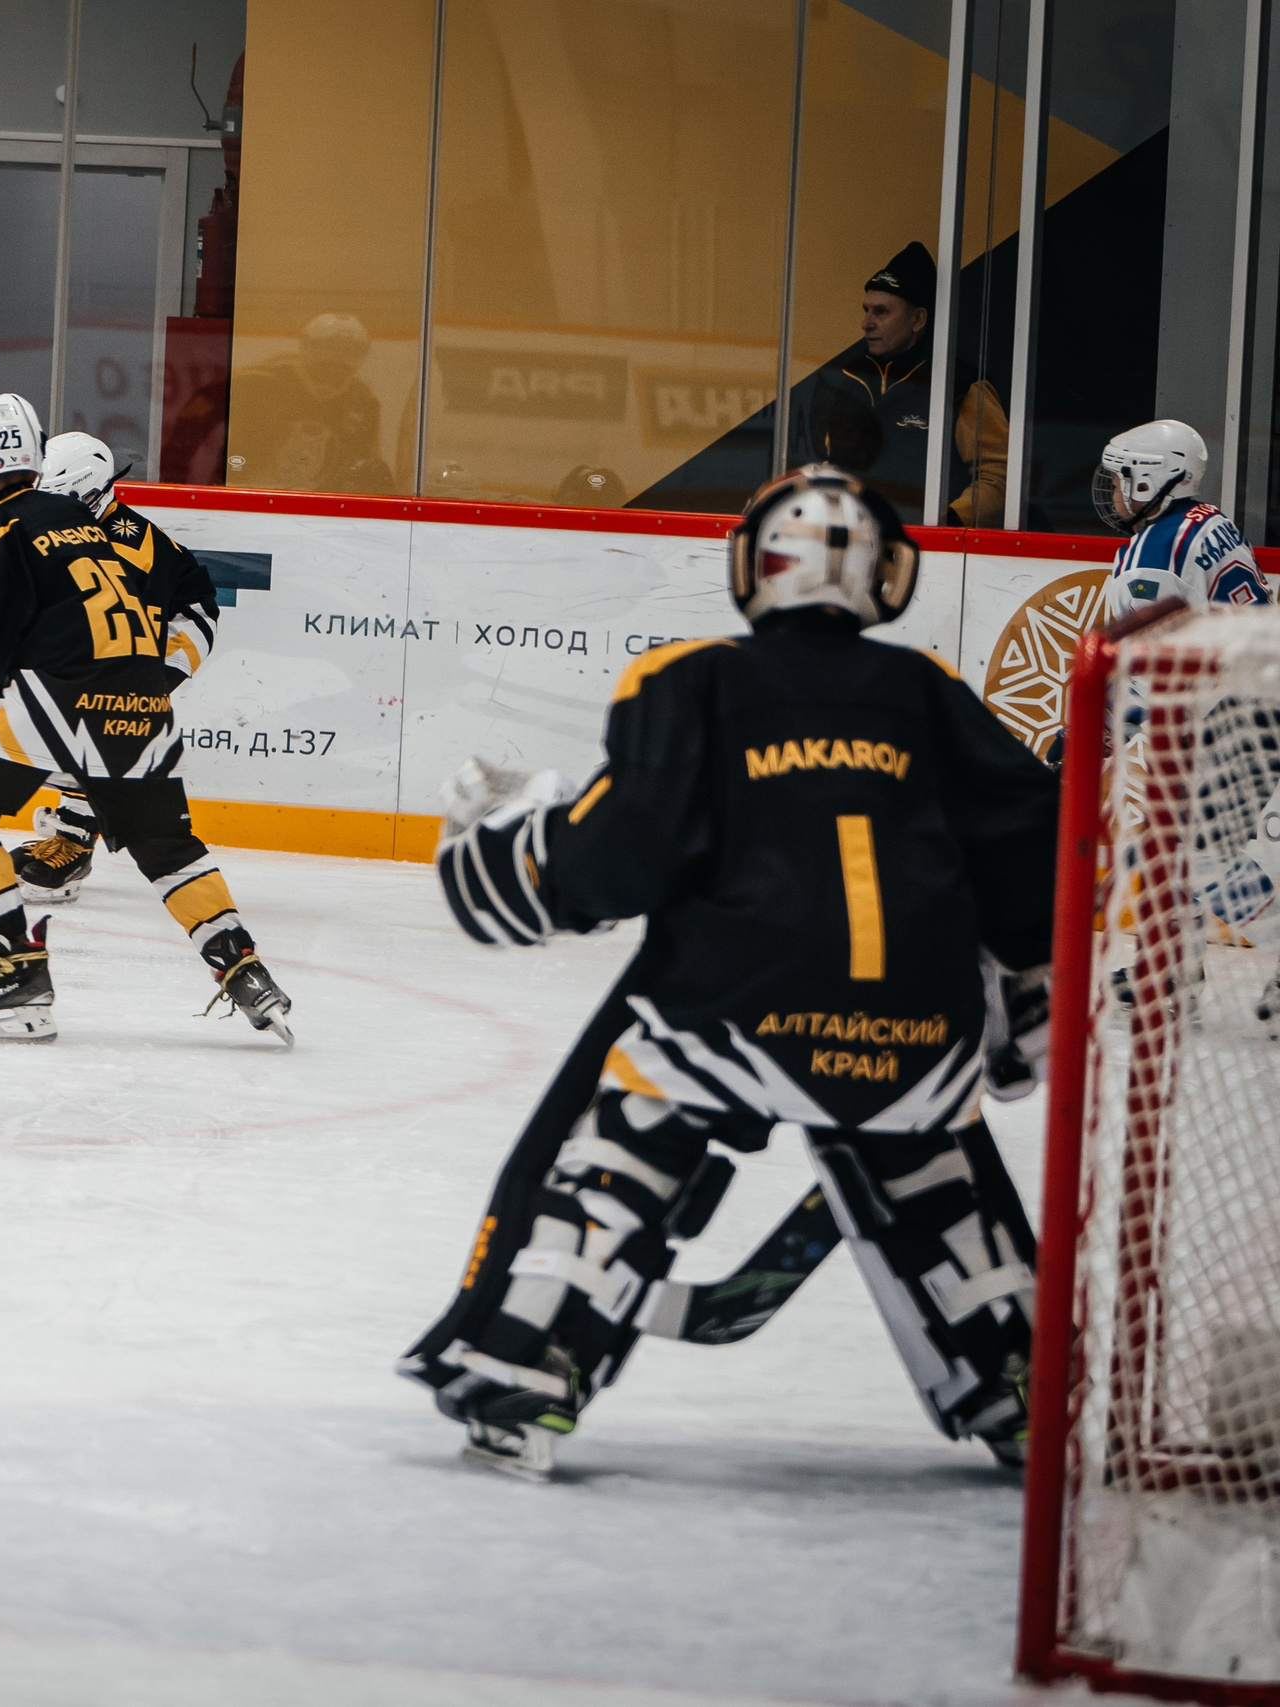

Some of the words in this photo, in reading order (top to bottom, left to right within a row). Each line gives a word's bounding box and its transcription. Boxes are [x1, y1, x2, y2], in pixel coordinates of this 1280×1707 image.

[67, 556, 160, 660] 25
[305, 613, 440, 641] КЛИМАТ
[474, 624, 588, 656] ХОЛОД
[103, 717, 152, 737] КРАЙ
[249, 728, 336, 758] д.137
[745, 737, 911, 781] MAKAROV
[837, 814, 885, 981] 1
[755, 1012, 948, 1045] АЛТАЙСКИЙ
[810, 1048, 899, 1082] КРАЙ
